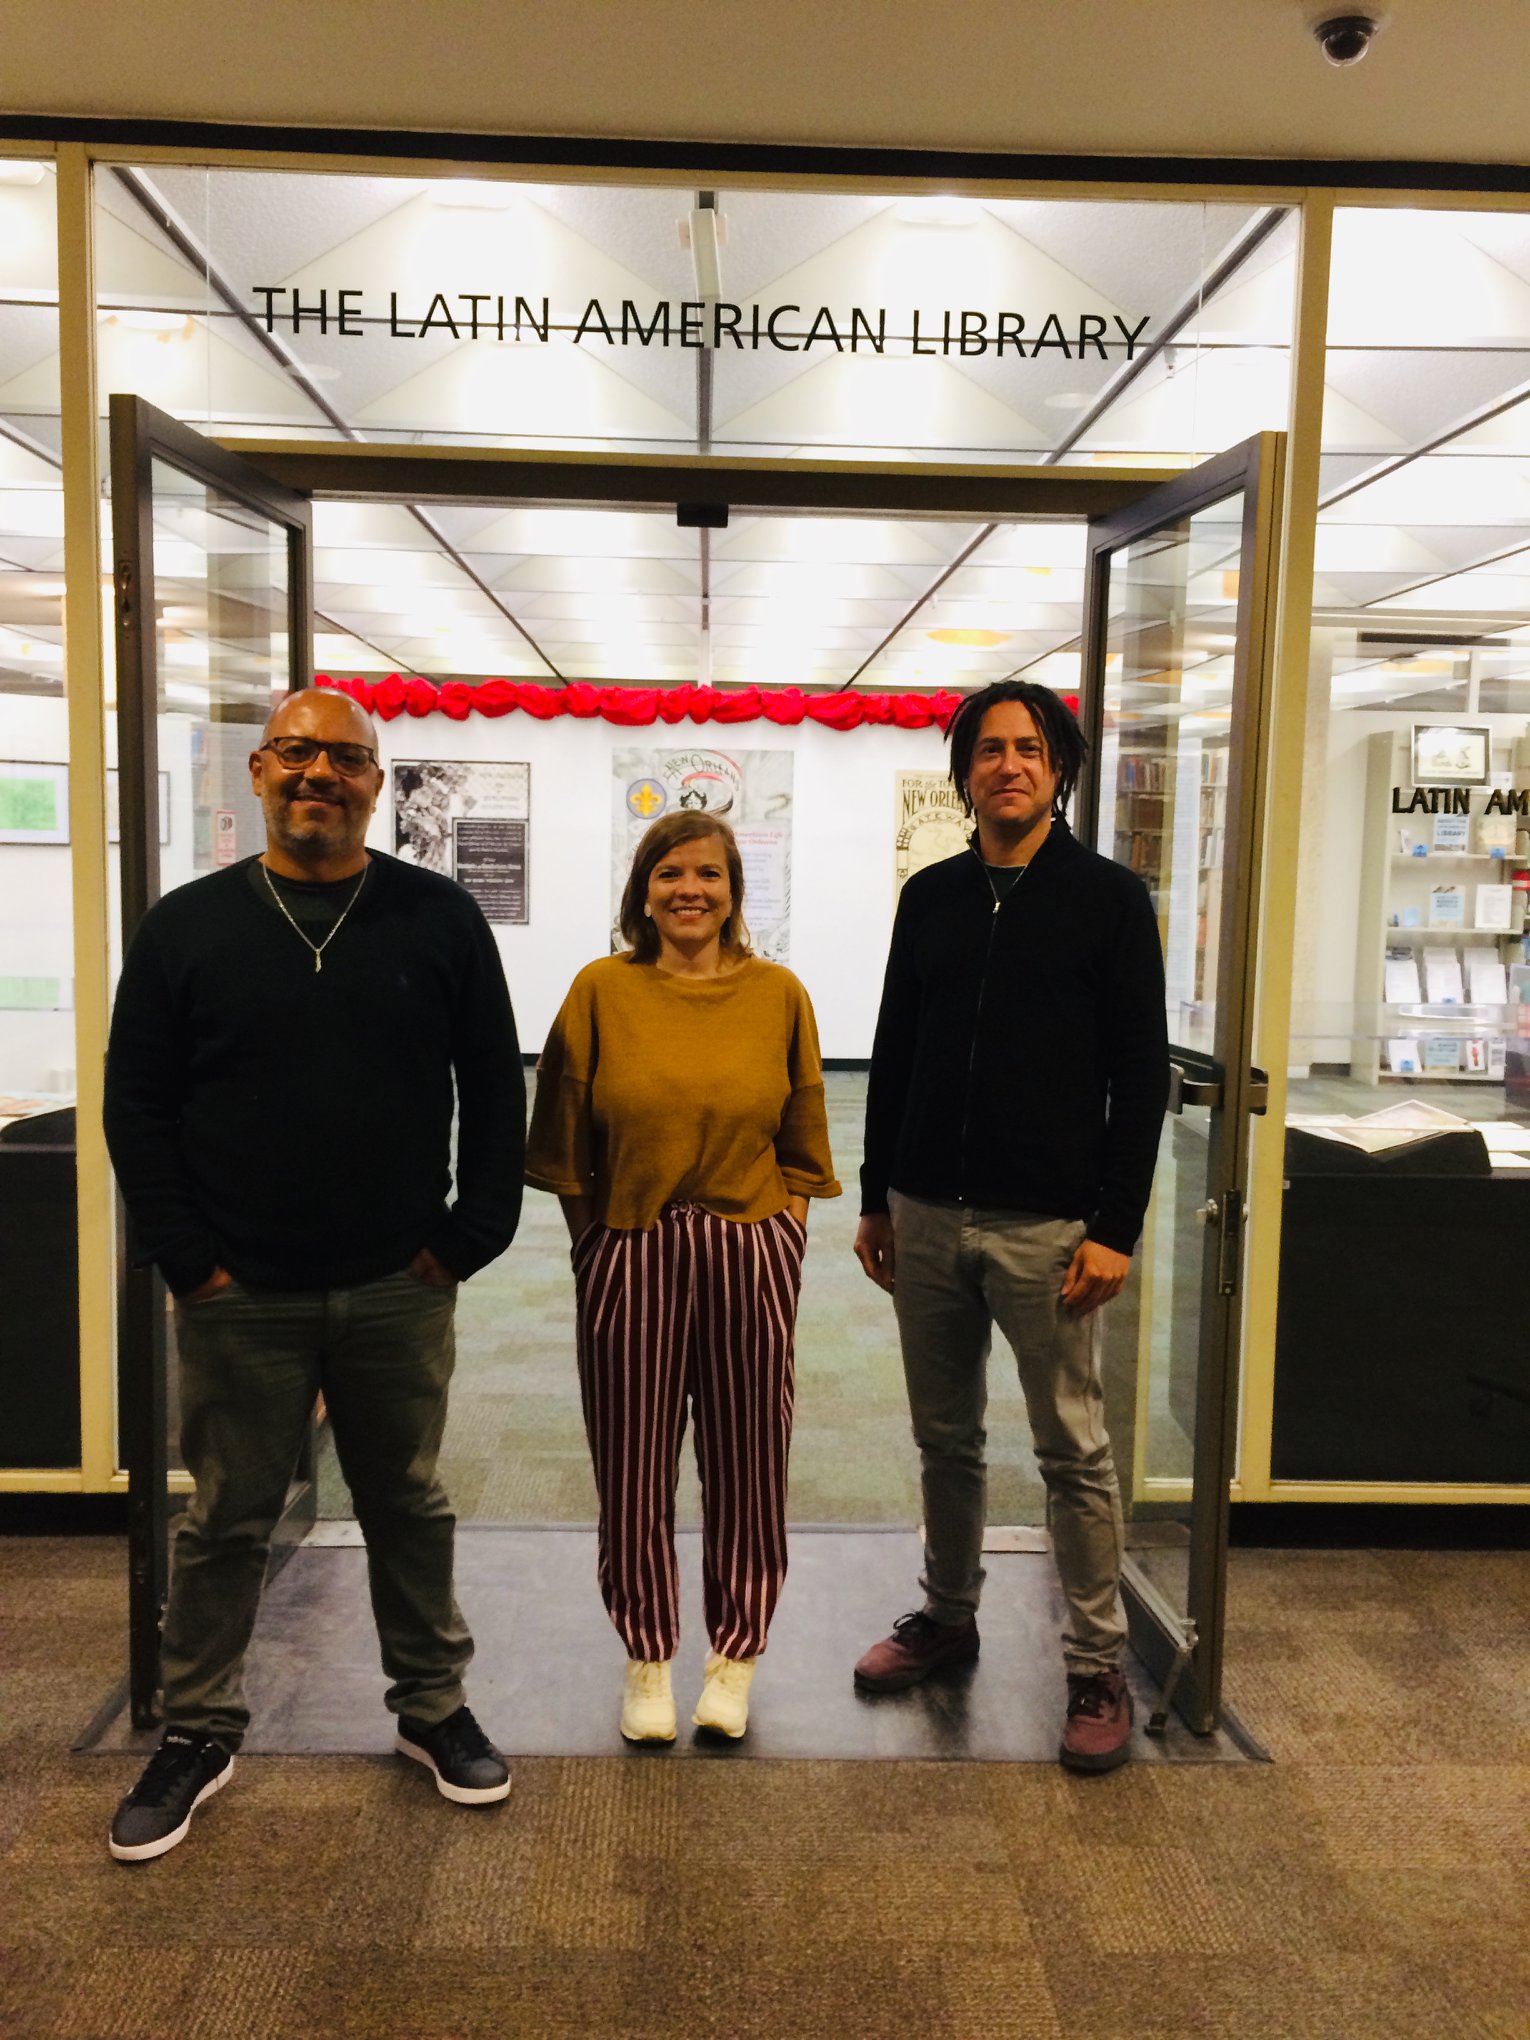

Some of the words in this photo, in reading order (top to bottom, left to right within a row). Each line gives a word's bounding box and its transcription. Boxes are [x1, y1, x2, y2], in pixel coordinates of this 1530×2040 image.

[252, 286, 363, 336] THE
[390, 291, 549, 342] LATIN
[573, 298, 886, 354] AMERICAN
[912, 309, 1151, 360] LIBRARY
[902, 779, 923, 788] FOR
[902, 789, 926, 825] NEW
[1392, 786, 1471, 814] LATIN
[1484, 788, 1530, 815] AM
